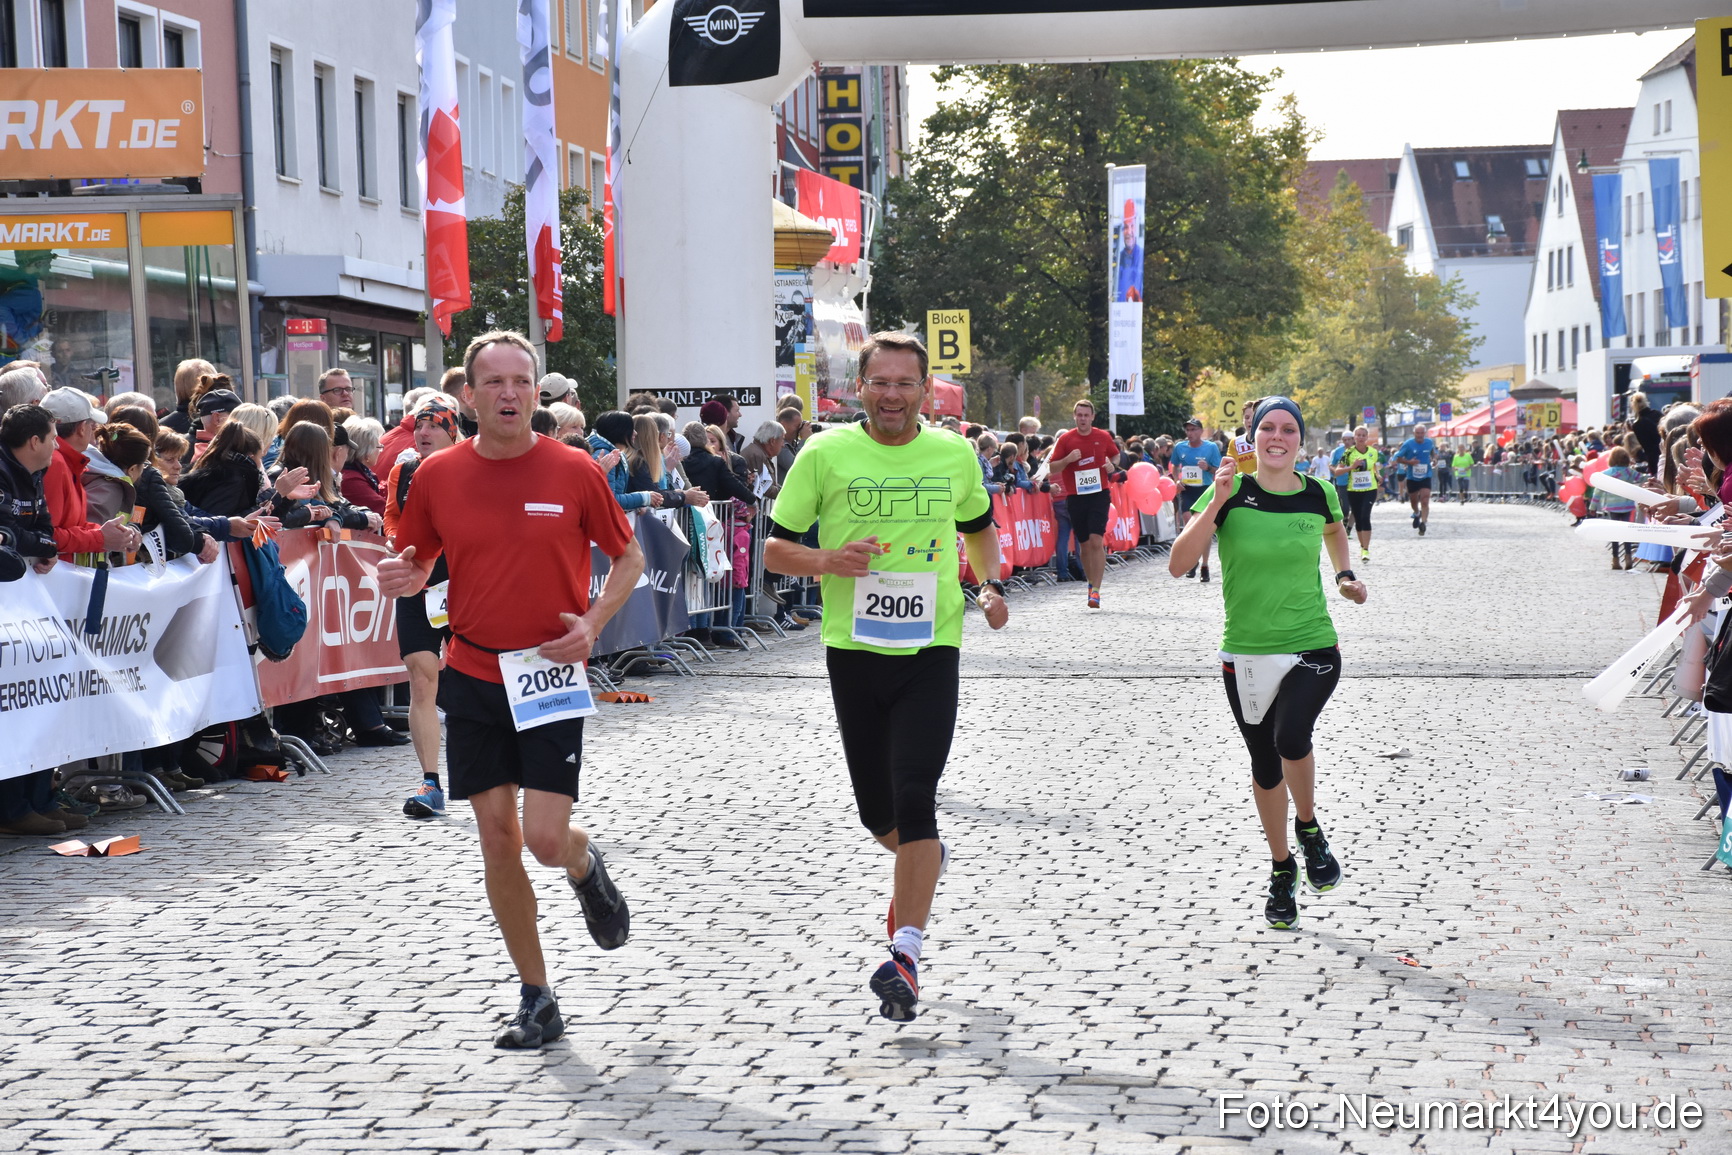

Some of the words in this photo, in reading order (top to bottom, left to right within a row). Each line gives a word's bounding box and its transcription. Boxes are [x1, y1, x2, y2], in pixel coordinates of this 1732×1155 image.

[709, 18, 738, 32] MINI
[932, 313, 965, 324] Block
[938, 329, 960, 360] B
[1222, 400, 1236, 417] C
[1548, 410, 1558, 423] D
[1079, 476, 1098, 485] 2498
[865, 593, 924, 619] 2906
[518, 664, 578, 697] 2082
[538, 696, 572, 711] Heribert
